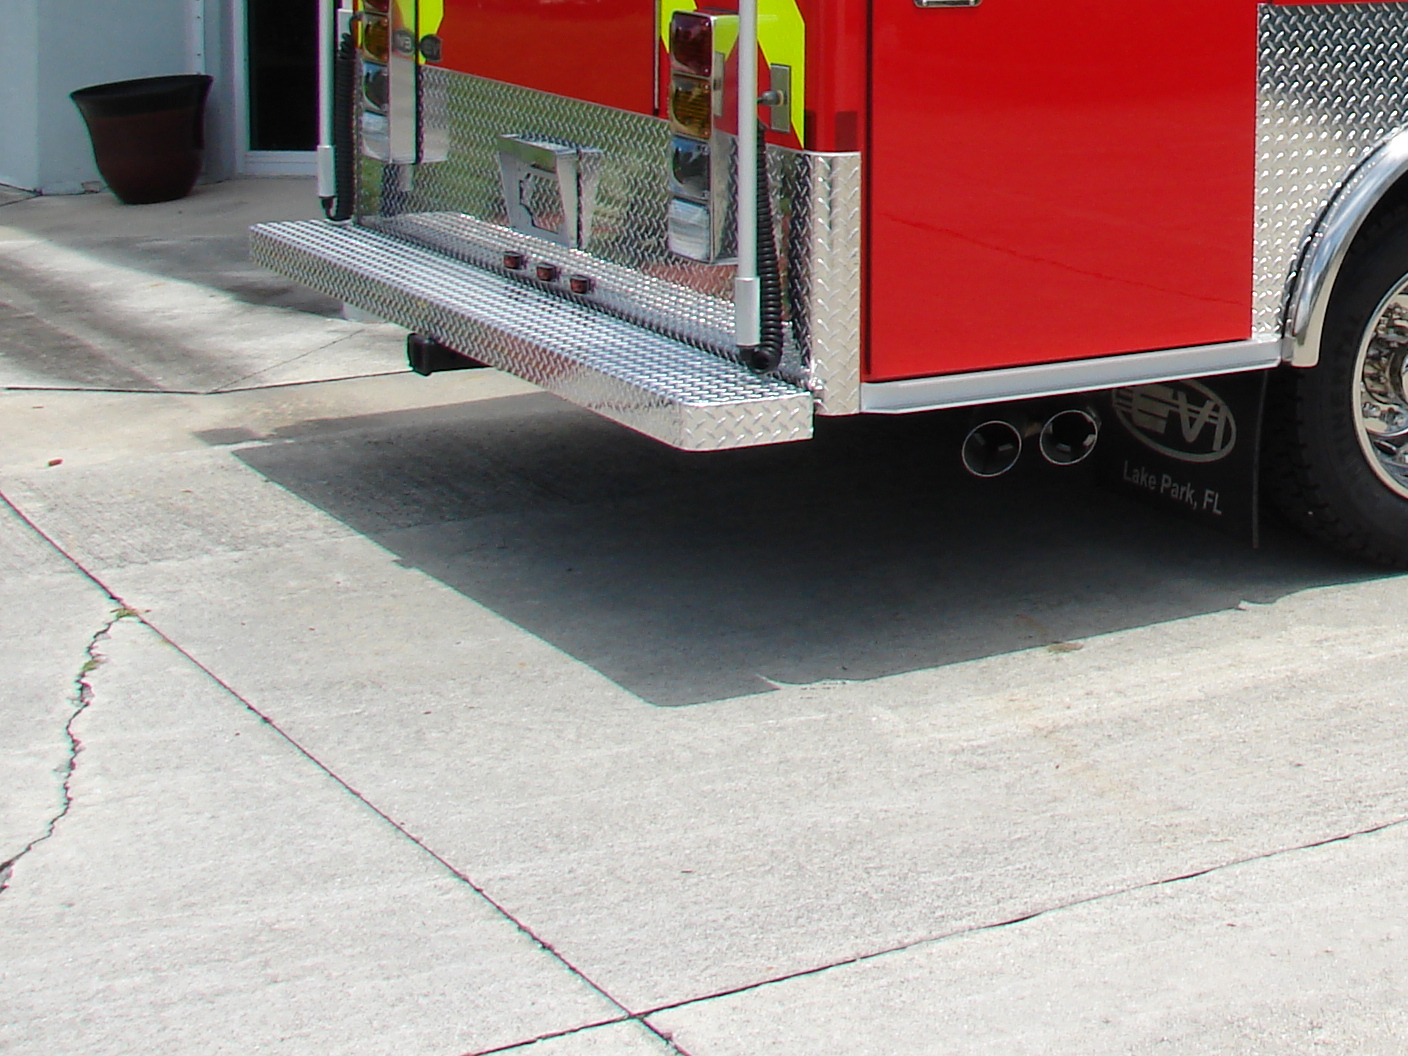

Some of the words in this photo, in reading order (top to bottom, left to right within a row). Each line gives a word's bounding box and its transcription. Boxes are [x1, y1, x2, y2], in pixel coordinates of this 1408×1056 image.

[1122, 459, 1157, 490] Lake
[1159, 473, 1198, 510] Park,
[1202, 488, 1223, 516] FL
